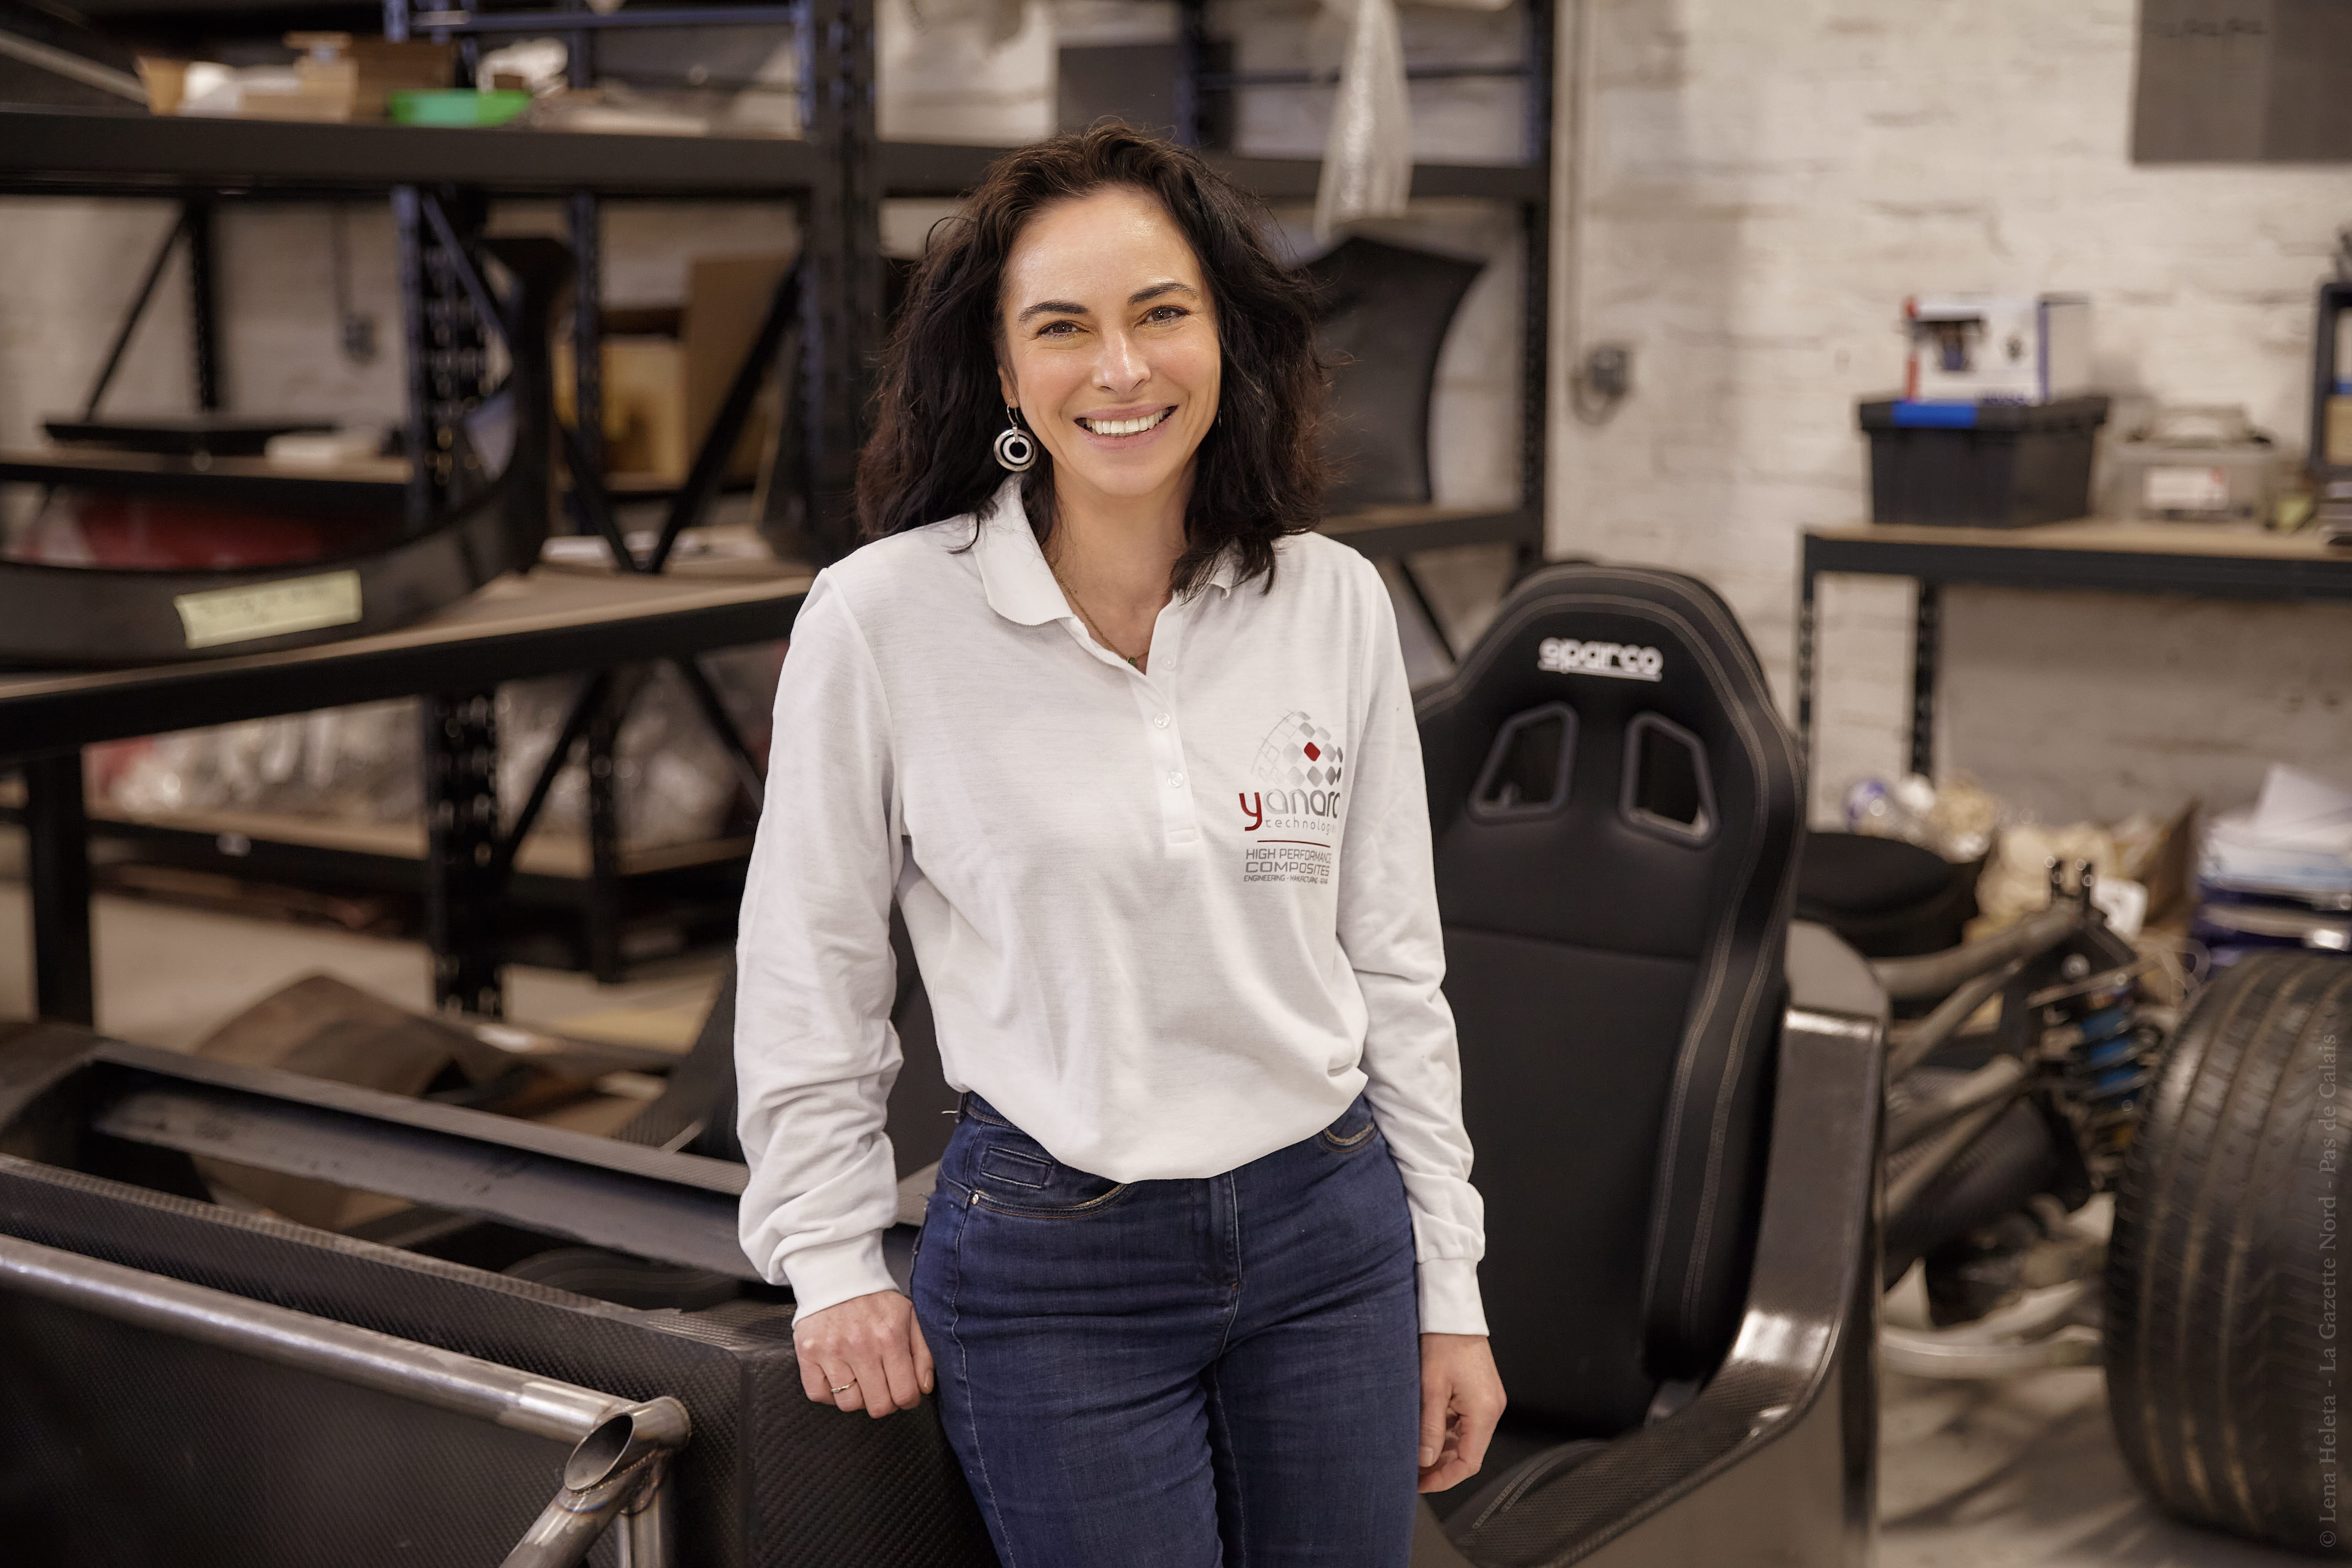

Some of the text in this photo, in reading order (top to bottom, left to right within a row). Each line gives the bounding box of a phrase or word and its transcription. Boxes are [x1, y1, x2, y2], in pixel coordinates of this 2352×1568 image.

[1538, 637, 1663, 676] sparco
[1246, 848, 1332, 864] HIGH PERFORMANCE
[1246, 862, 1330, 876] COMPOSITES
